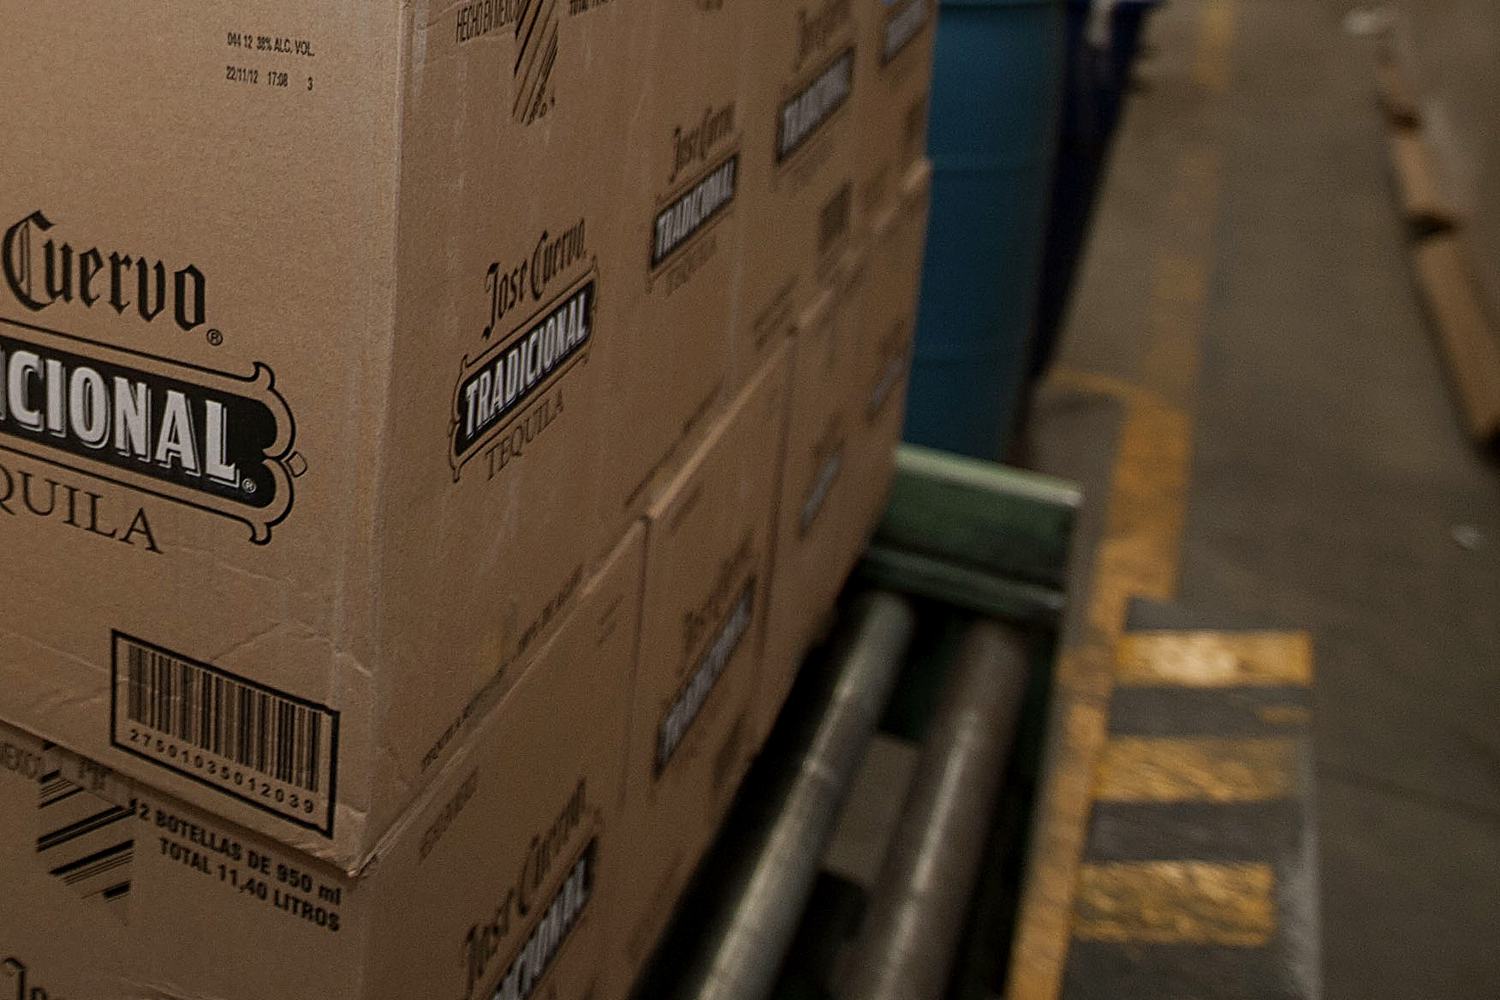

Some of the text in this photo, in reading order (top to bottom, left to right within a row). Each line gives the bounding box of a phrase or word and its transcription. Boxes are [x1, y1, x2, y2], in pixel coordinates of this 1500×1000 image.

[294, 39, 316, 57] VOL.
[1, 209, 207, 332] Cuervo
[481, 258, 528, 341] Jose
[465, 292, 588, 442] TRADICIONAL
[484, 388, 566, 482] TEQUILA
[128, 727, 316, 815] 27501035012039
[154, 808, 243, 863] BOTELLAS
[247, 850, 273, 876] DE
[277, 862, 314, 894] 950
[318, 883, 343, 906] ml
[159, 835, 341, 933] TOTAL 11,40 LITROS
